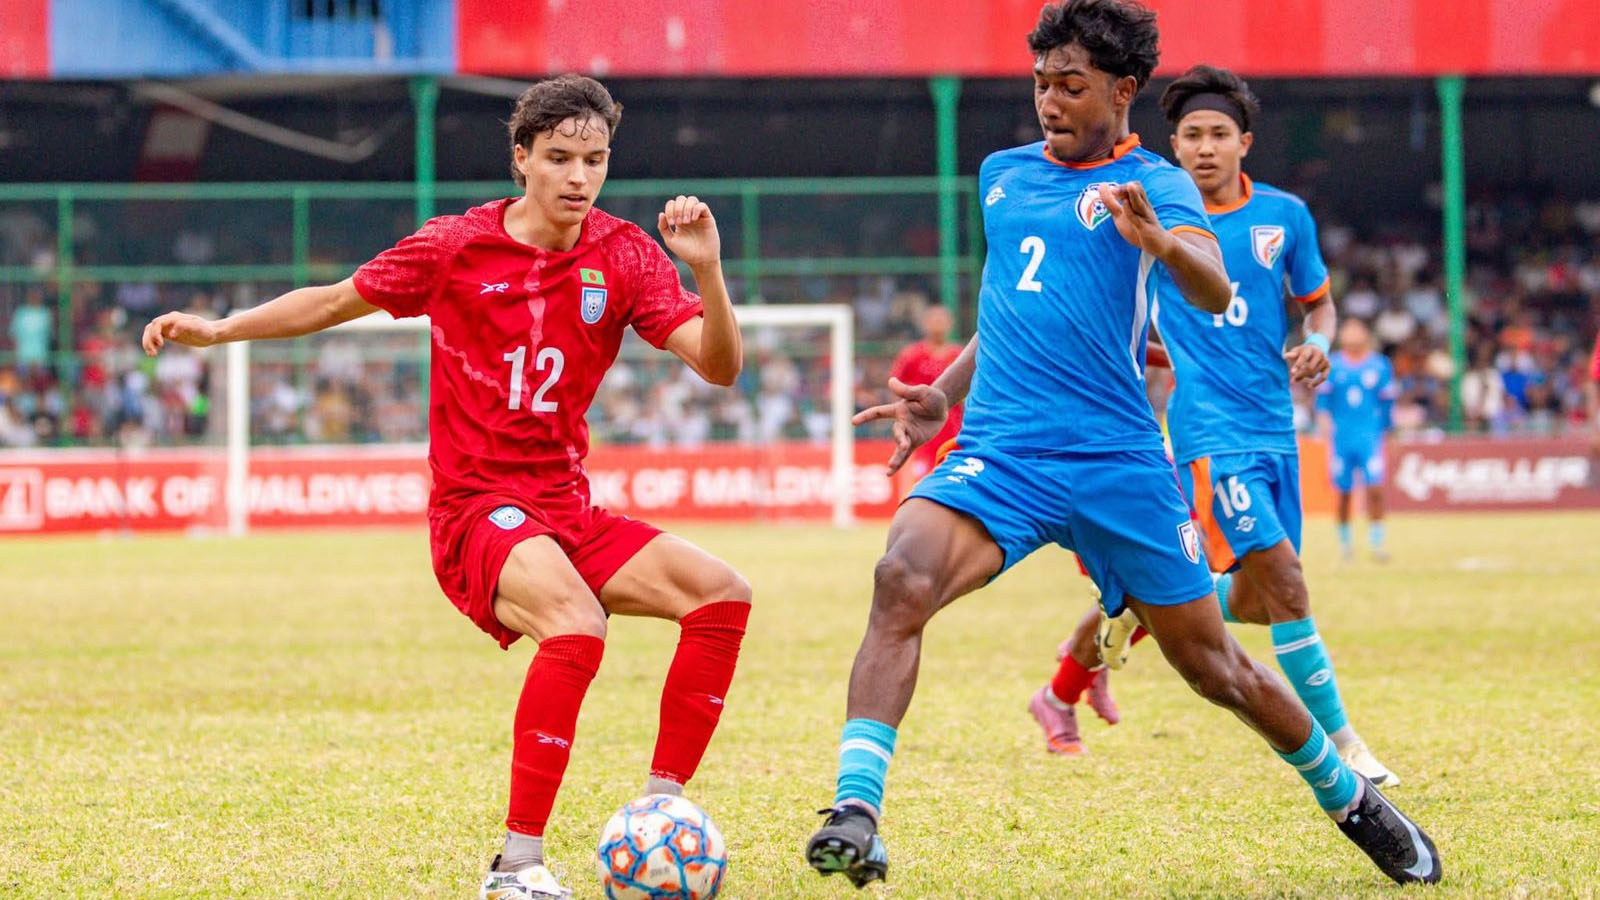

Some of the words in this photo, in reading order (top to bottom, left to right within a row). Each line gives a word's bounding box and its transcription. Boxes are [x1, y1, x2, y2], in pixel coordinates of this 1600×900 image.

[1016, 236, 1046, 293] 2
[503, 346, 565, 412] 12
[632, 467, 688, 508] OF
[951, 457, 985, 477] 2
[45, 476, 158, 518] BANK
[163, 475, 216, 517] OF
[1214, 475, 1252, 519] 16
